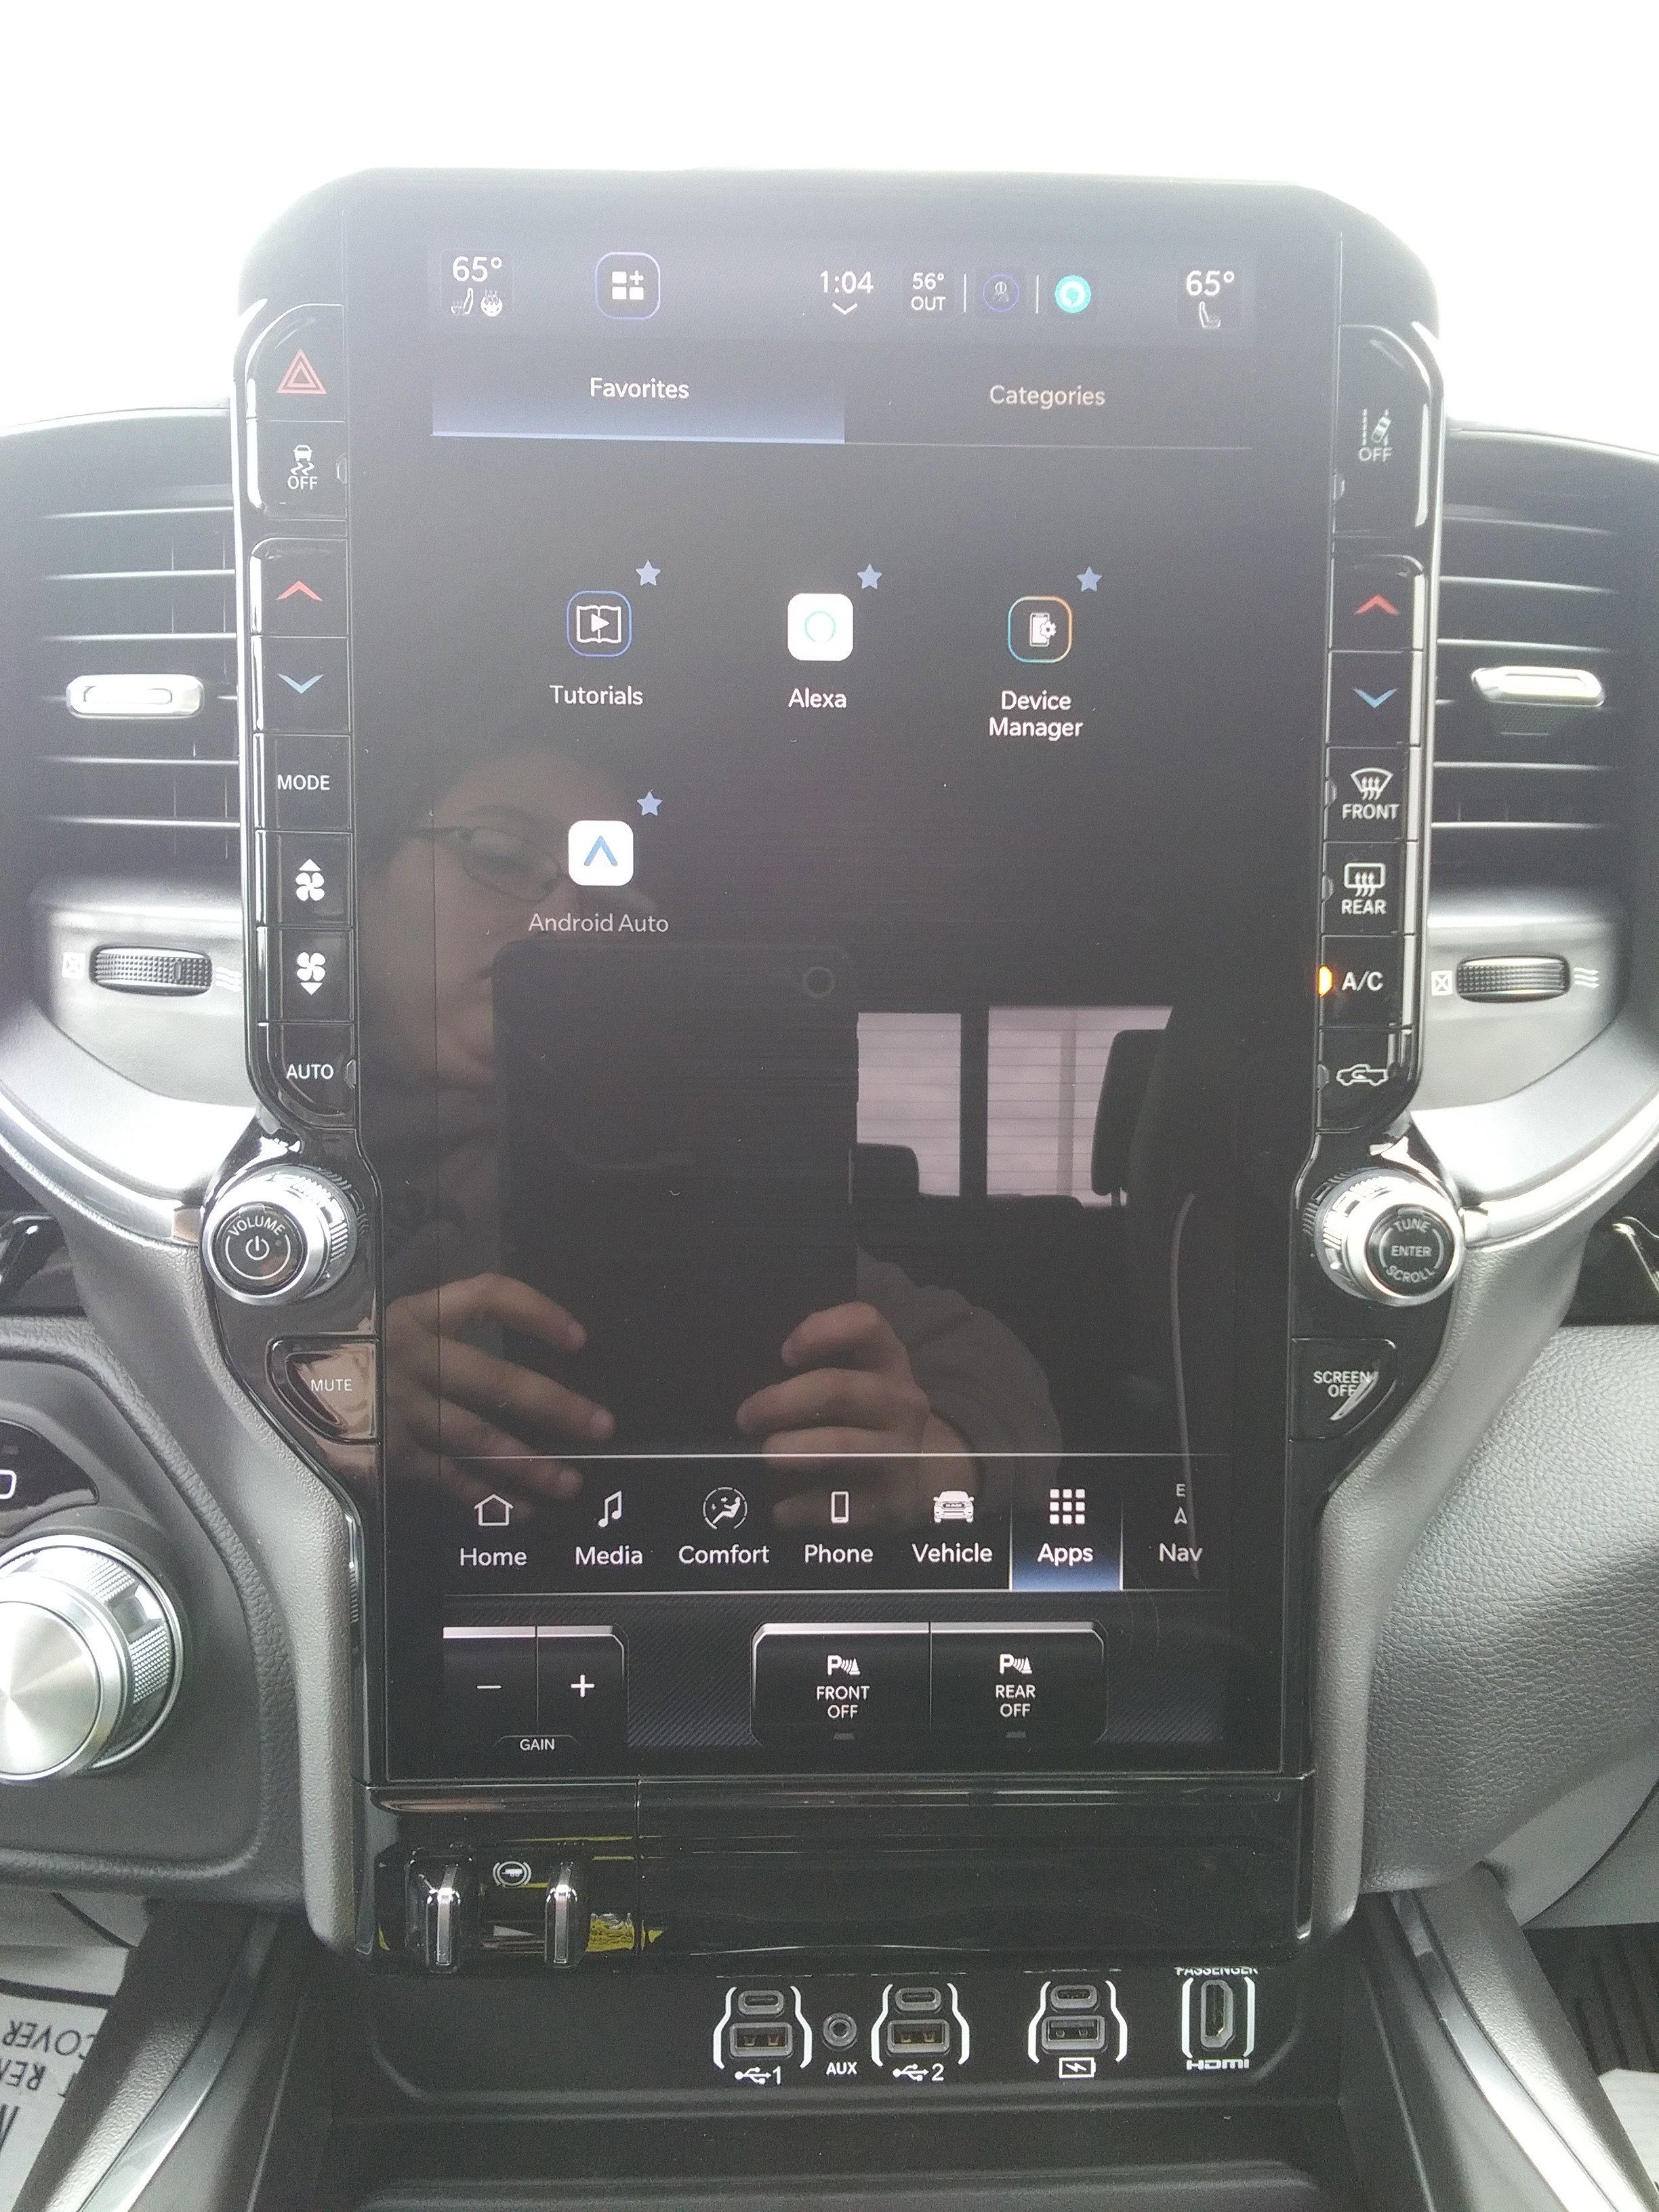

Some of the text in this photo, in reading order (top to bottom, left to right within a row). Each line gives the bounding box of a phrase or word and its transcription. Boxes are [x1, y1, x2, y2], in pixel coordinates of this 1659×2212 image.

[453, 255, 502, 283] 65°
[820, 270, 874, 294] 1:04
[912, 272, 945, 290] 56°
[1186, 270, 1235, 296] 65°
[911, 295, 947, 311] OUT
[590, 377, 689, 399] Favorites
[989, 384, 1105, 410] Categories
[1358, 447, 1393, 462] OFF
[287, 475, 318, 490] OFF
[549, 684, 643, 705] Tutorials
[788, 687, 846, 708] Alexa
[1001, 690, 1071, 710] Device
[989, 716, 1084, 741] Manager
[277, 774, 330, 790] MODE
[1342, 803, 1399, 819] FRONT
[1341, 899, 1386, 914] REAR
[528, 912, 669, 933] Android Auto
[1341, 971, 1383, 991] A/C
[286, 1063, 334, 1080] AUTO
[228, 1215, 285, 1237] VOLUME
[1393, 1218, 1431, 1233] TUNE
[1391, 1245, 1432, 1257] ENTER
[1385, 1265, 1435, 1283] SCROLL
[310, 1378, 352, 1392] MUTE
[1313, 1370, 1371, 1384] SCREEN
[1328, 1384, 1357, 1397] OFF
[460, 1547, 527, 1566] Home
[575, 1545, 643, 1565] Media
[678, 1544, 770, 1564] Comfort
[804, 1543, 874, 1563] Phone
[912, 1542, 993, 1563] Vehicle
[1037, 1543, 1093, 1567] Apps
[1160, 1543, 1203, 1562] Nav
[817, 1685, 870, 1700] FRONT
[996, 1684, 1036, 1698] REAR
[827, 1704, 859, 1719] OFF
[1000, 1703, 1031, 1717] OFF
[520, 1738, 555, 1751] GAIN
[1174, 1966, 1258, 1976] PASSENGER
[825, 2062, 857, 2075] AUX
[1186, 2058, 1250, 2070] HDMI
